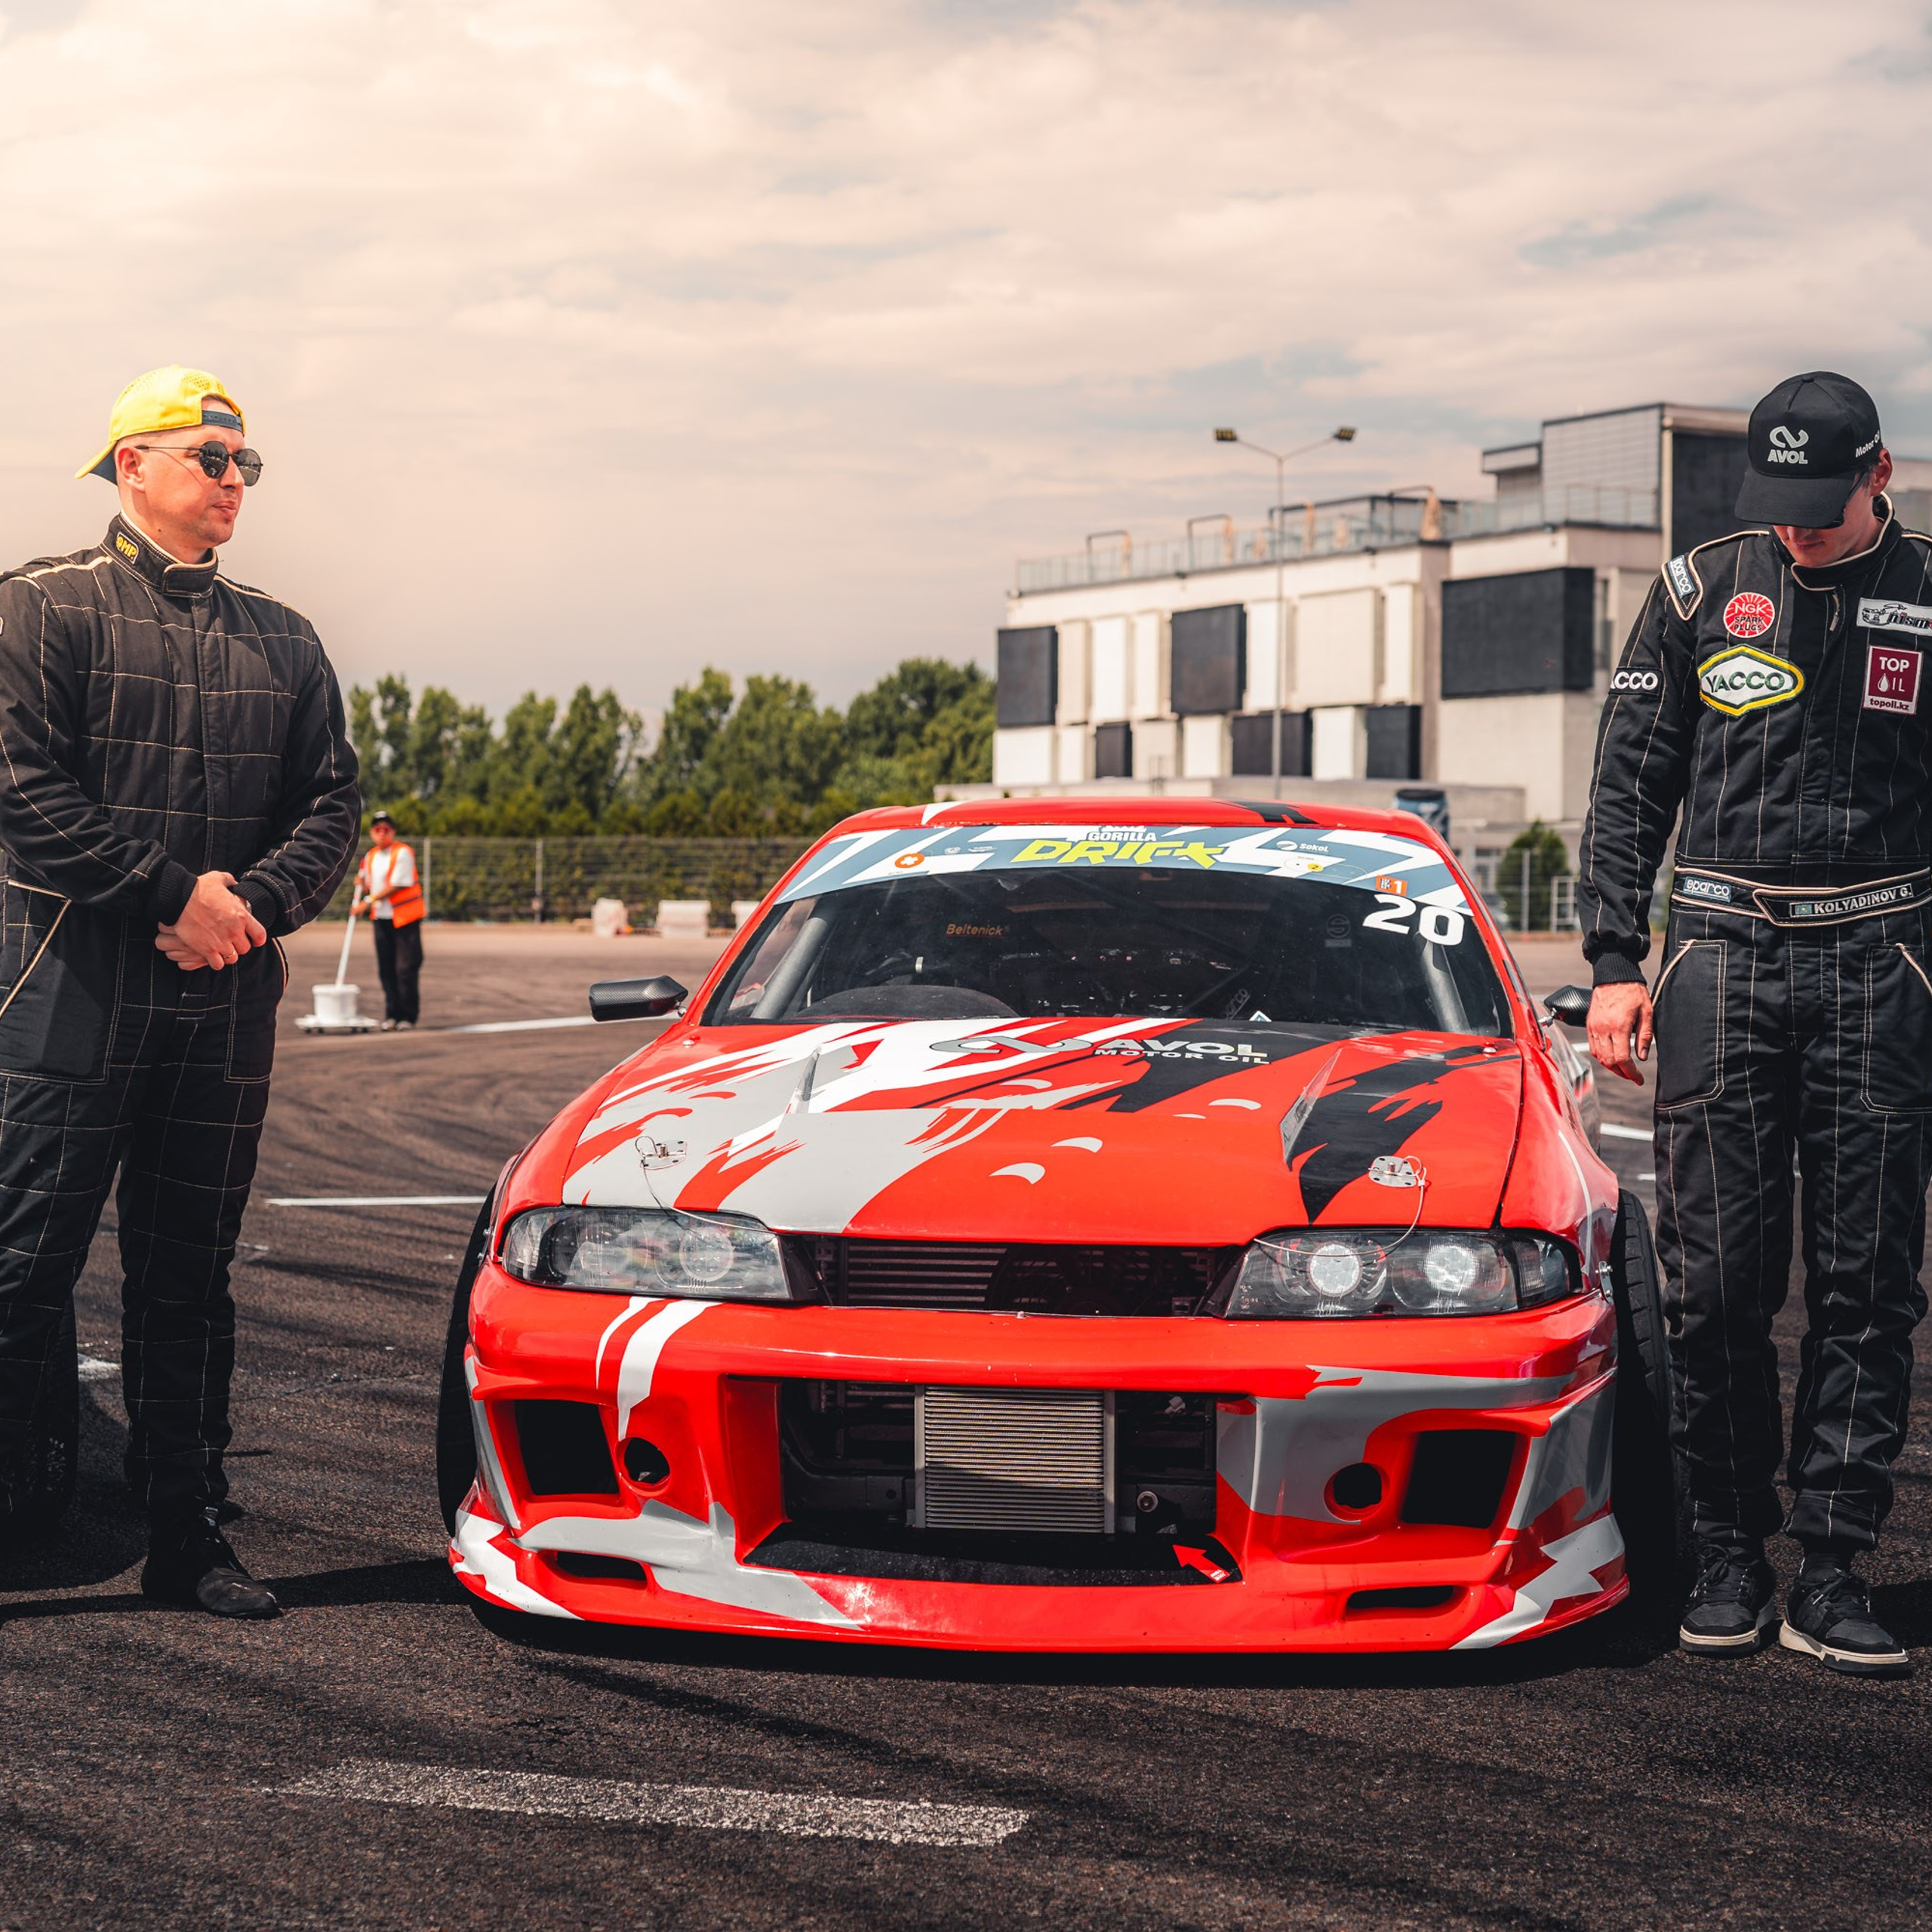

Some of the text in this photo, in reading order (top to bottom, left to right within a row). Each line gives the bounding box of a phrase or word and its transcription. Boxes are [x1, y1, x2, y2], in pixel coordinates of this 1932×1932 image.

[1767, 449, 1808, 465] AVOL
[1855, 440, 1874, 457] Motor
[115, 536, 137, 558] OMP
[1672, 558, 1692, 593] sparco
[1734, 602, 1766, 614] NGK
[1734, 616, 1764, 624] SPARK
[1887, 611, 1932, 629] nism
[1879, 657, 1910, 672] TOP
[1706, 671, 1786, 693] YACCO
[1088, 831, 1157, 842] GORILLA
[1011, 838, 1224, 869] DRIFT
[1687, 879, 1729, 896] sparco
[1814, 887, 1912, 914] KOLYADINOV G.
[1362, 894, 1465, 946] 20
[946, 923, 1003, 936] Beltenick
[1097, 1038, 1268, 1057] AVOL
[1094, 1049, 1270, 1065] MOTOR OIL
